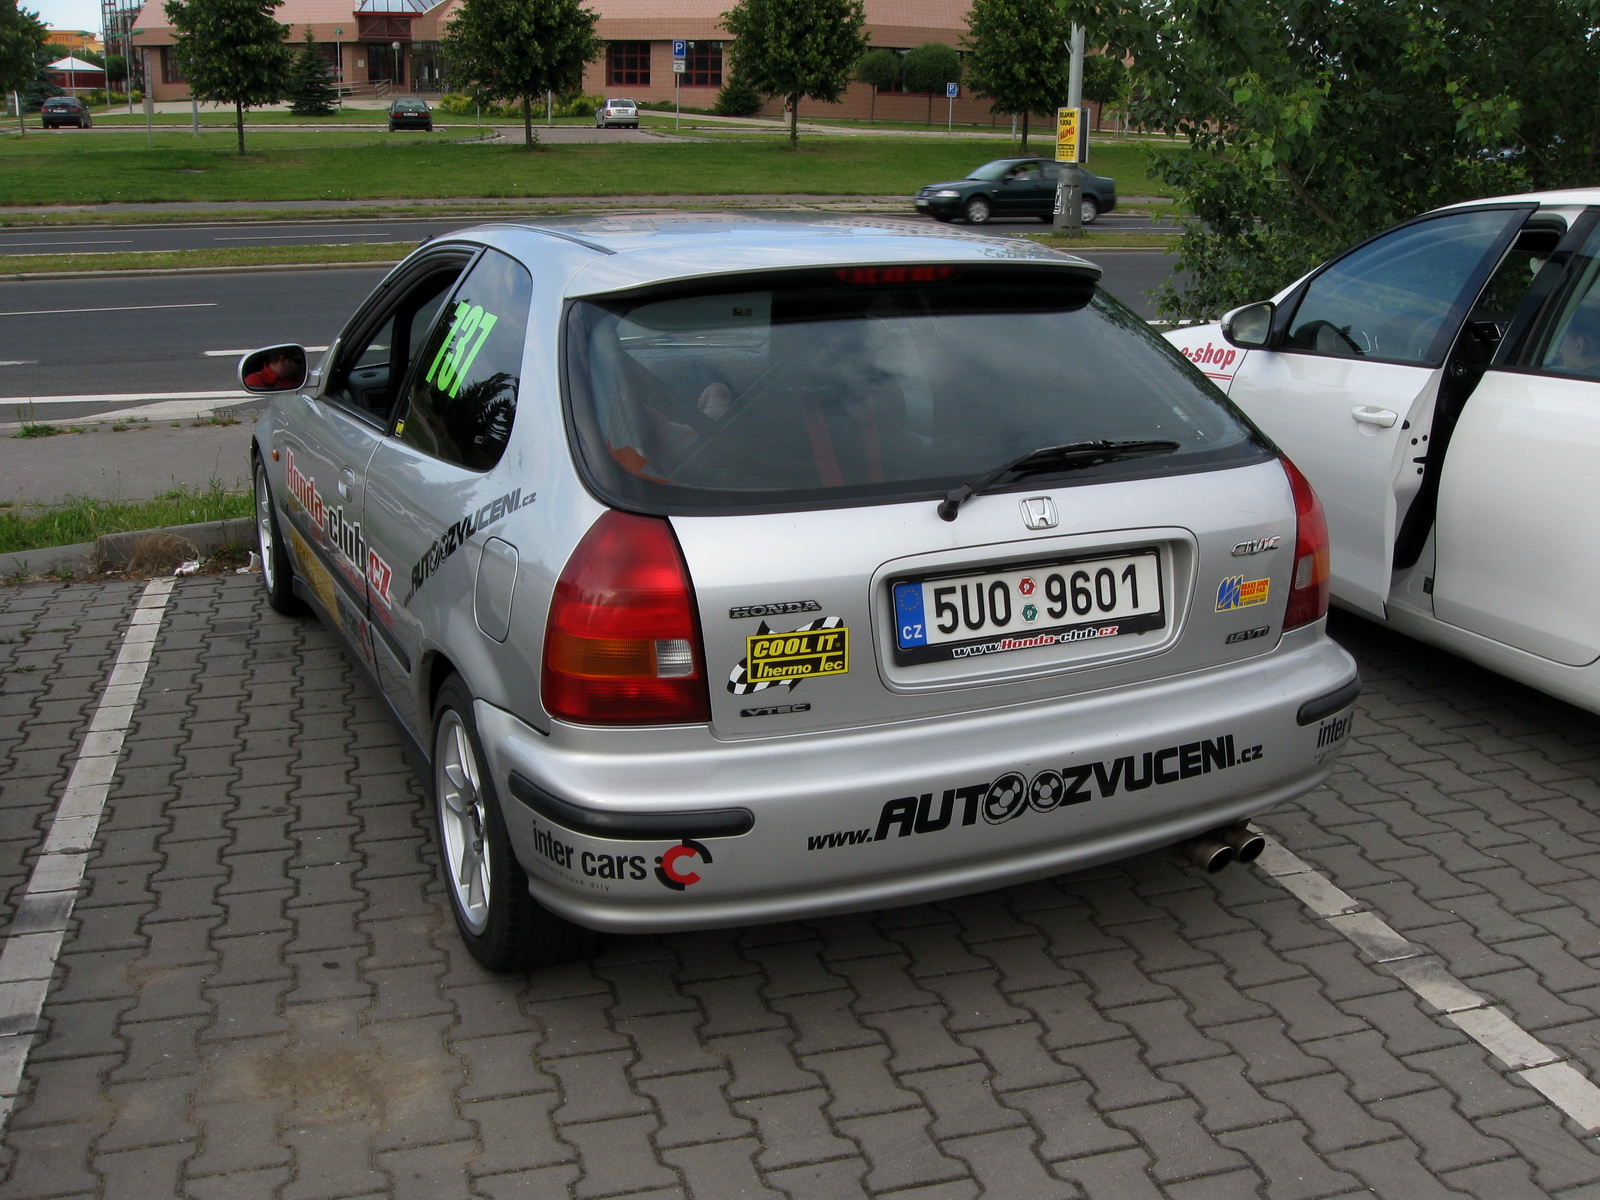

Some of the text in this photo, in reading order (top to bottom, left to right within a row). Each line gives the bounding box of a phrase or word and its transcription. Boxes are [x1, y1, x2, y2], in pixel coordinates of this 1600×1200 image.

[1231, 536, 1281, 556] CIVIC
[730, 601, 820, 617] HONDA
[933, 564, 1140, 635] 5U0 9601
[902, 624, 923, 641] CZ
[753, 634, 839, 658] COOL IT
[752, 655, 844, 678] Thermo Tec
[744, 703, 808, 716] VTEC
[1317, 717, 1348, 748] inter
[532, 819, 648, 881] inter cars
